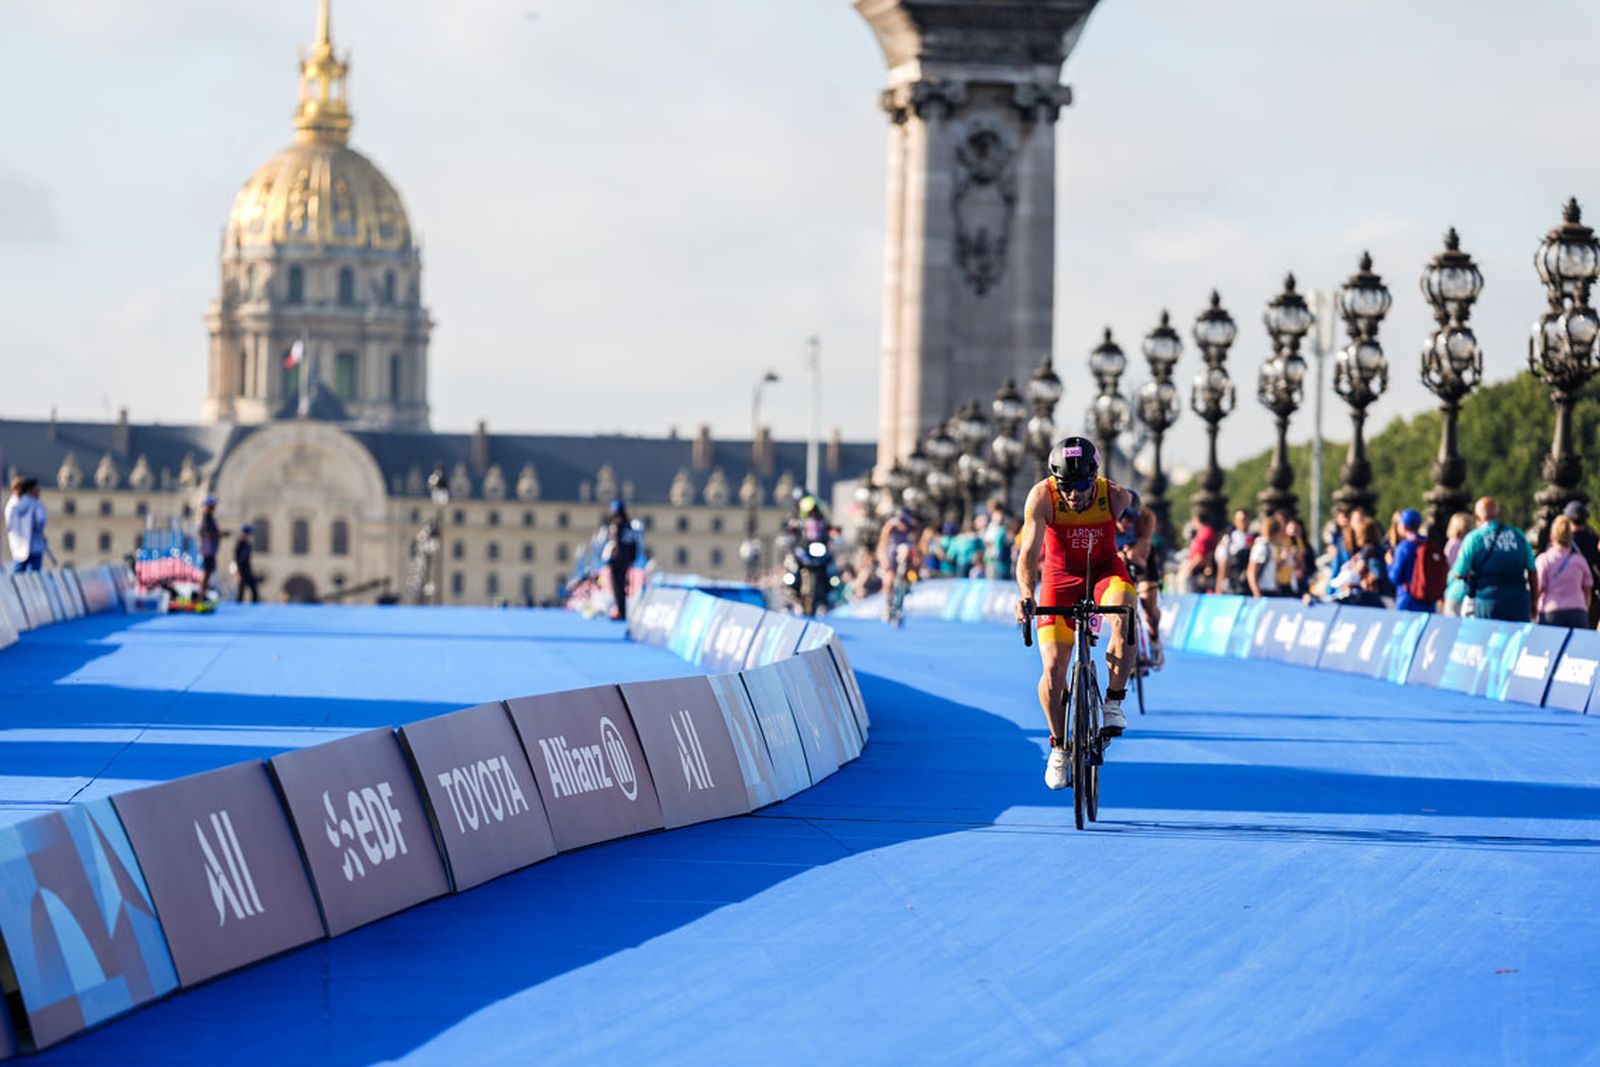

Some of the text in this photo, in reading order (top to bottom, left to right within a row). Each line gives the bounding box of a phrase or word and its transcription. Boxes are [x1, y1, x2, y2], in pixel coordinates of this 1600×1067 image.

[1072, 538, 1099, 549] ESP
[437, 754, 530, 833] TOYOTA
[538, 734, 613, 798] Allianz
